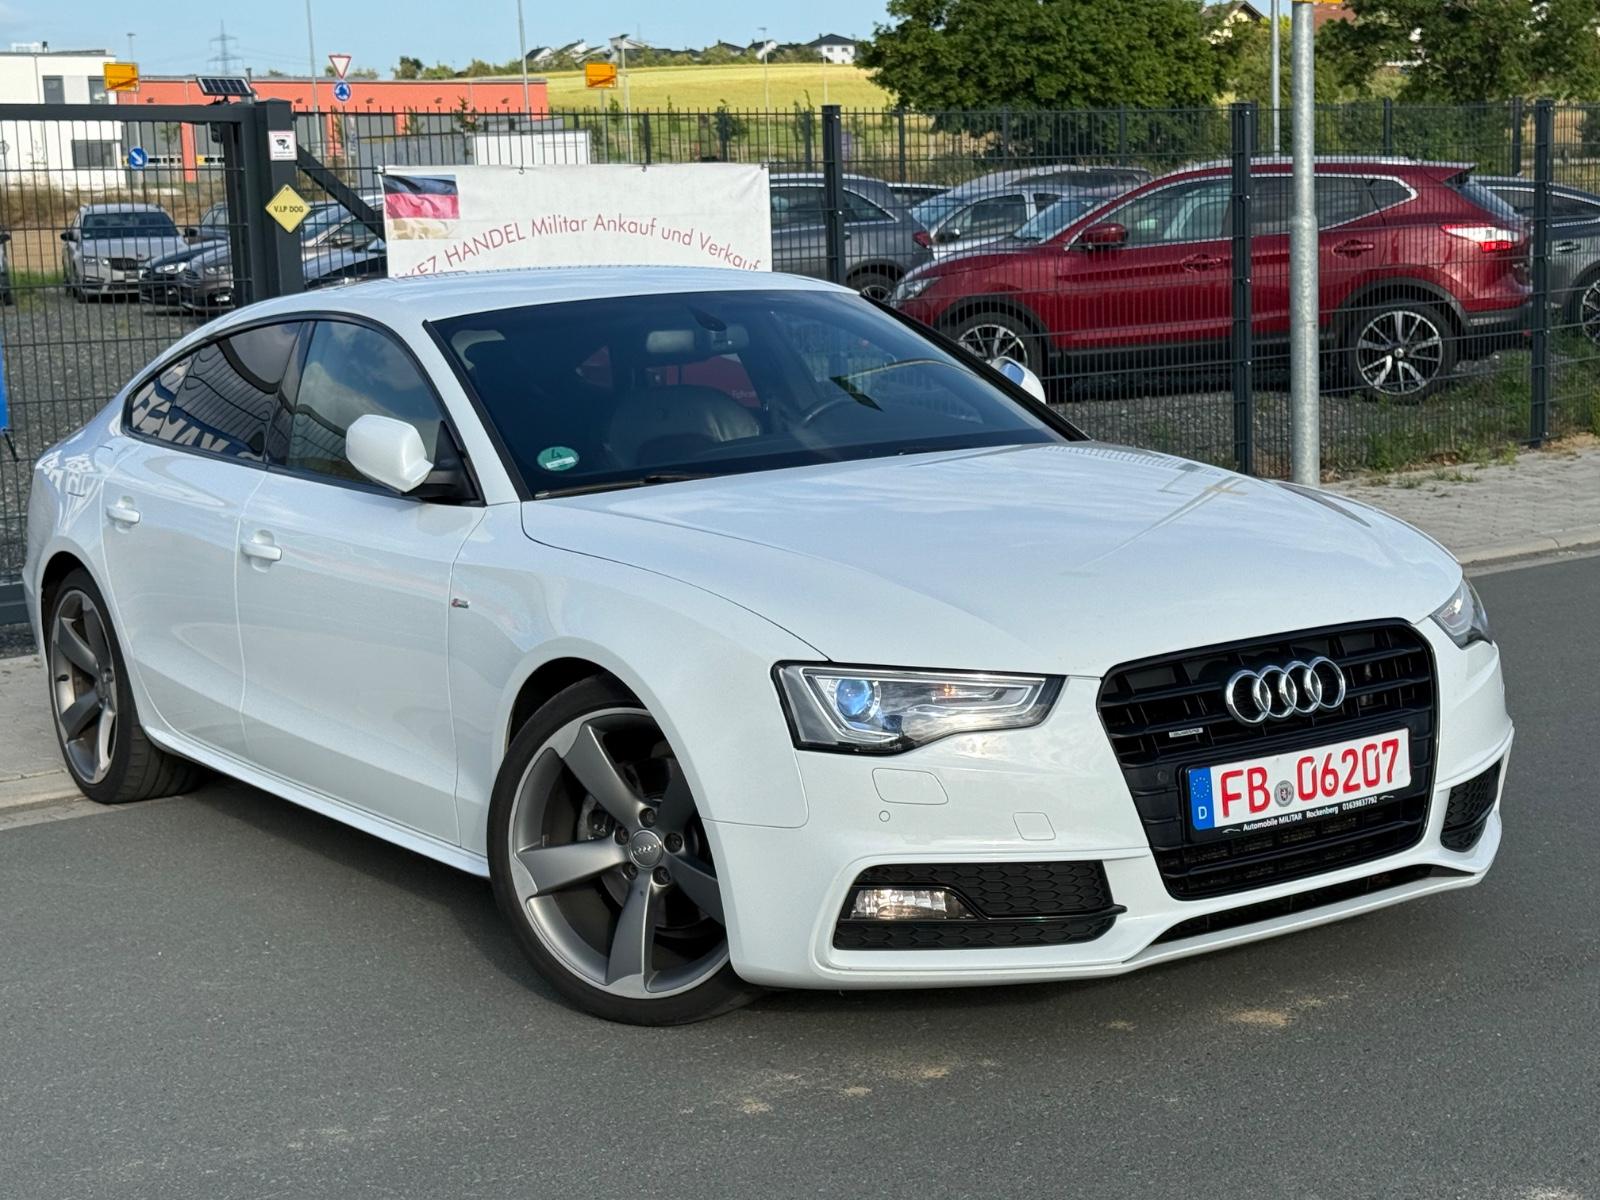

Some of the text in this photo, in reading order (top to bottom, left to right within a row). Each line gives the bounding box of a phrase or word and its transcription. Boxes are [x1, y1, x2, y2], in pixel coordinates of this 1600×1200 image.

[444, 223, 525, 266] HANDEL
[532, 214, 588, 237] Militar
[594, 213, 657, 236] Ankauf
[661, 218, 694, 246] und
[552, 449, 563, 459] 4
[1220, 738, 1399, 818] FB 06207
[1198, 806, 1208, 819] D
[1243, 818, 1278, 832] Automobile
[1278, 813, 1303, 826] MILITAR
[1306, 805, 1339, 820] Rockenberg
